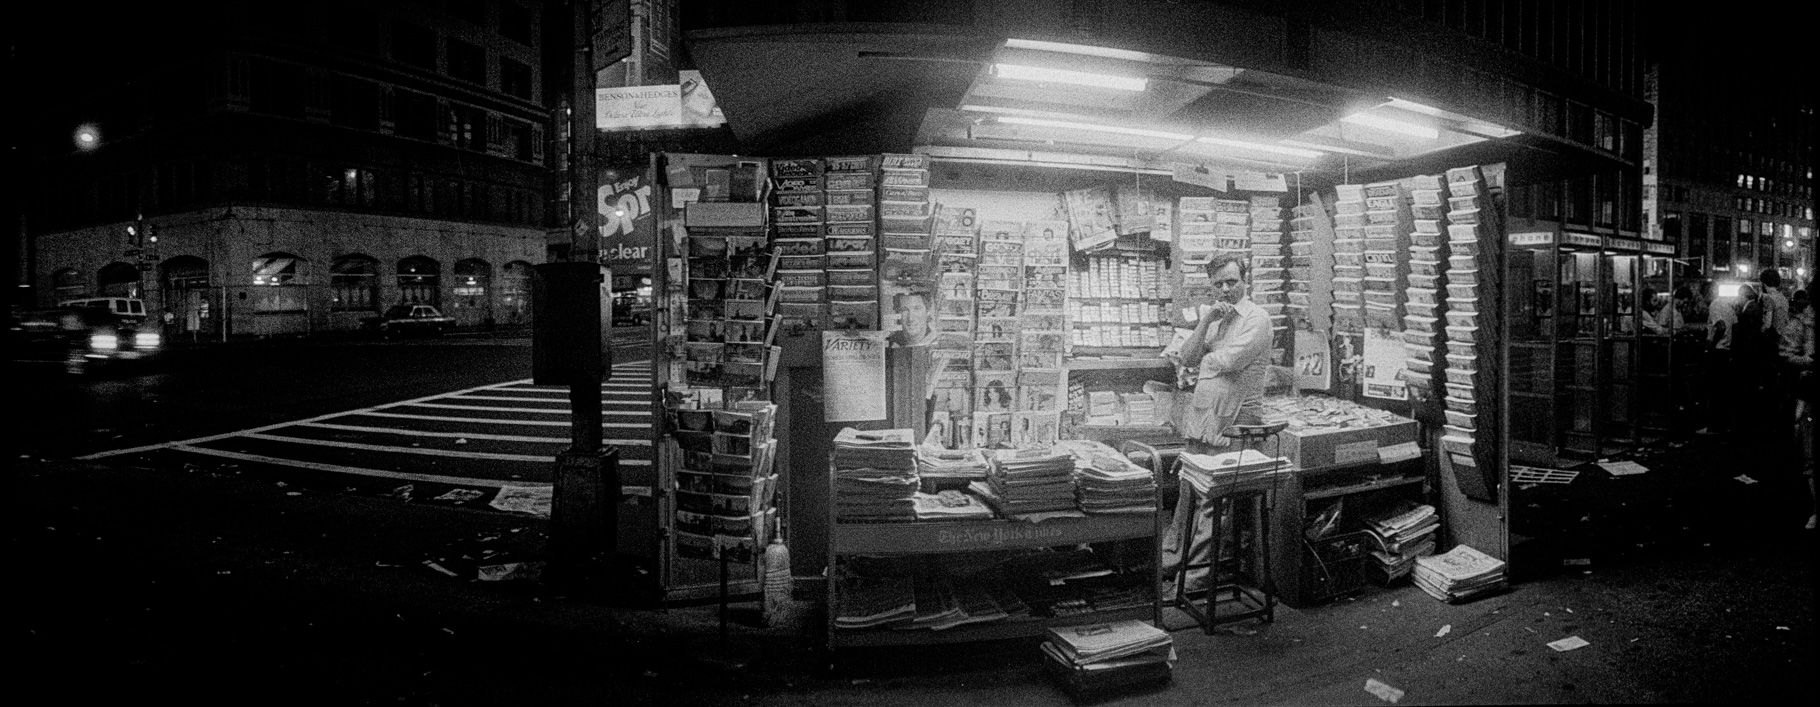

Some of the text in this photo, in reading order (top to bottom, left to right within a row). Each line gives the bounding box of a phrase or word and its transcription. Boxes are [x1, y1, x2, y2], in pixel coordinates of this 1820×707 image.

[599, 93, 634, 101] BENSON
[640, 91, 678, 99] HEDGES
[613, 175, 639, 193] Enjoy
[1512, 233, 1551, 244] phone
[610, 243, 648, 260] clear
[825, 337, 873, 351] VARIETY
[938, 525, 1063, 544] The New York Times
